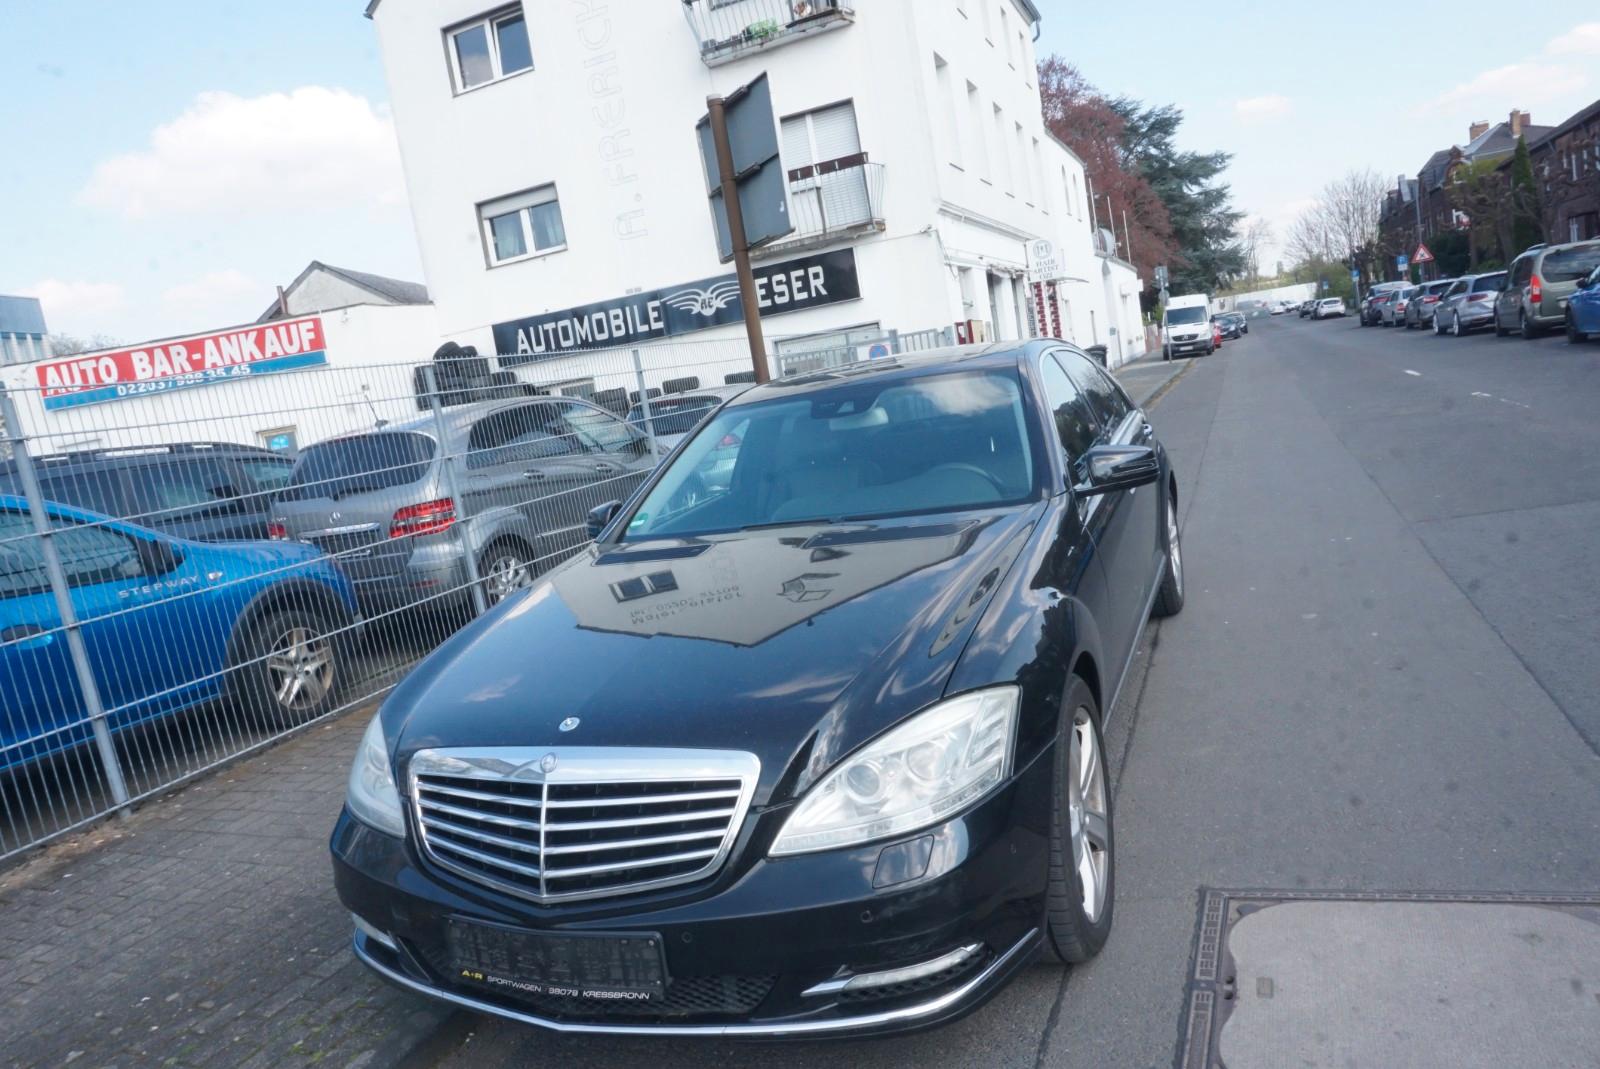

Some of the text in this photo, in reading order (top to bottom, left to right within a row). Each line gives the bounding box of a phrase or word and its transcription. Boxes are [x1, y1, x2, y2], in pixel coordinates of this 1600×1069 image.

[516, 265, 828, 355] AUTOMOBILE ESER
[46, 321, 316, 396] AUTO BAR-ANKAUF
[118, 575, 199, 599] STEPWAY
[487, 975, 542, 993] SPORTWAGEN
[582, 990, 650, 1000] KRESSBRONN
